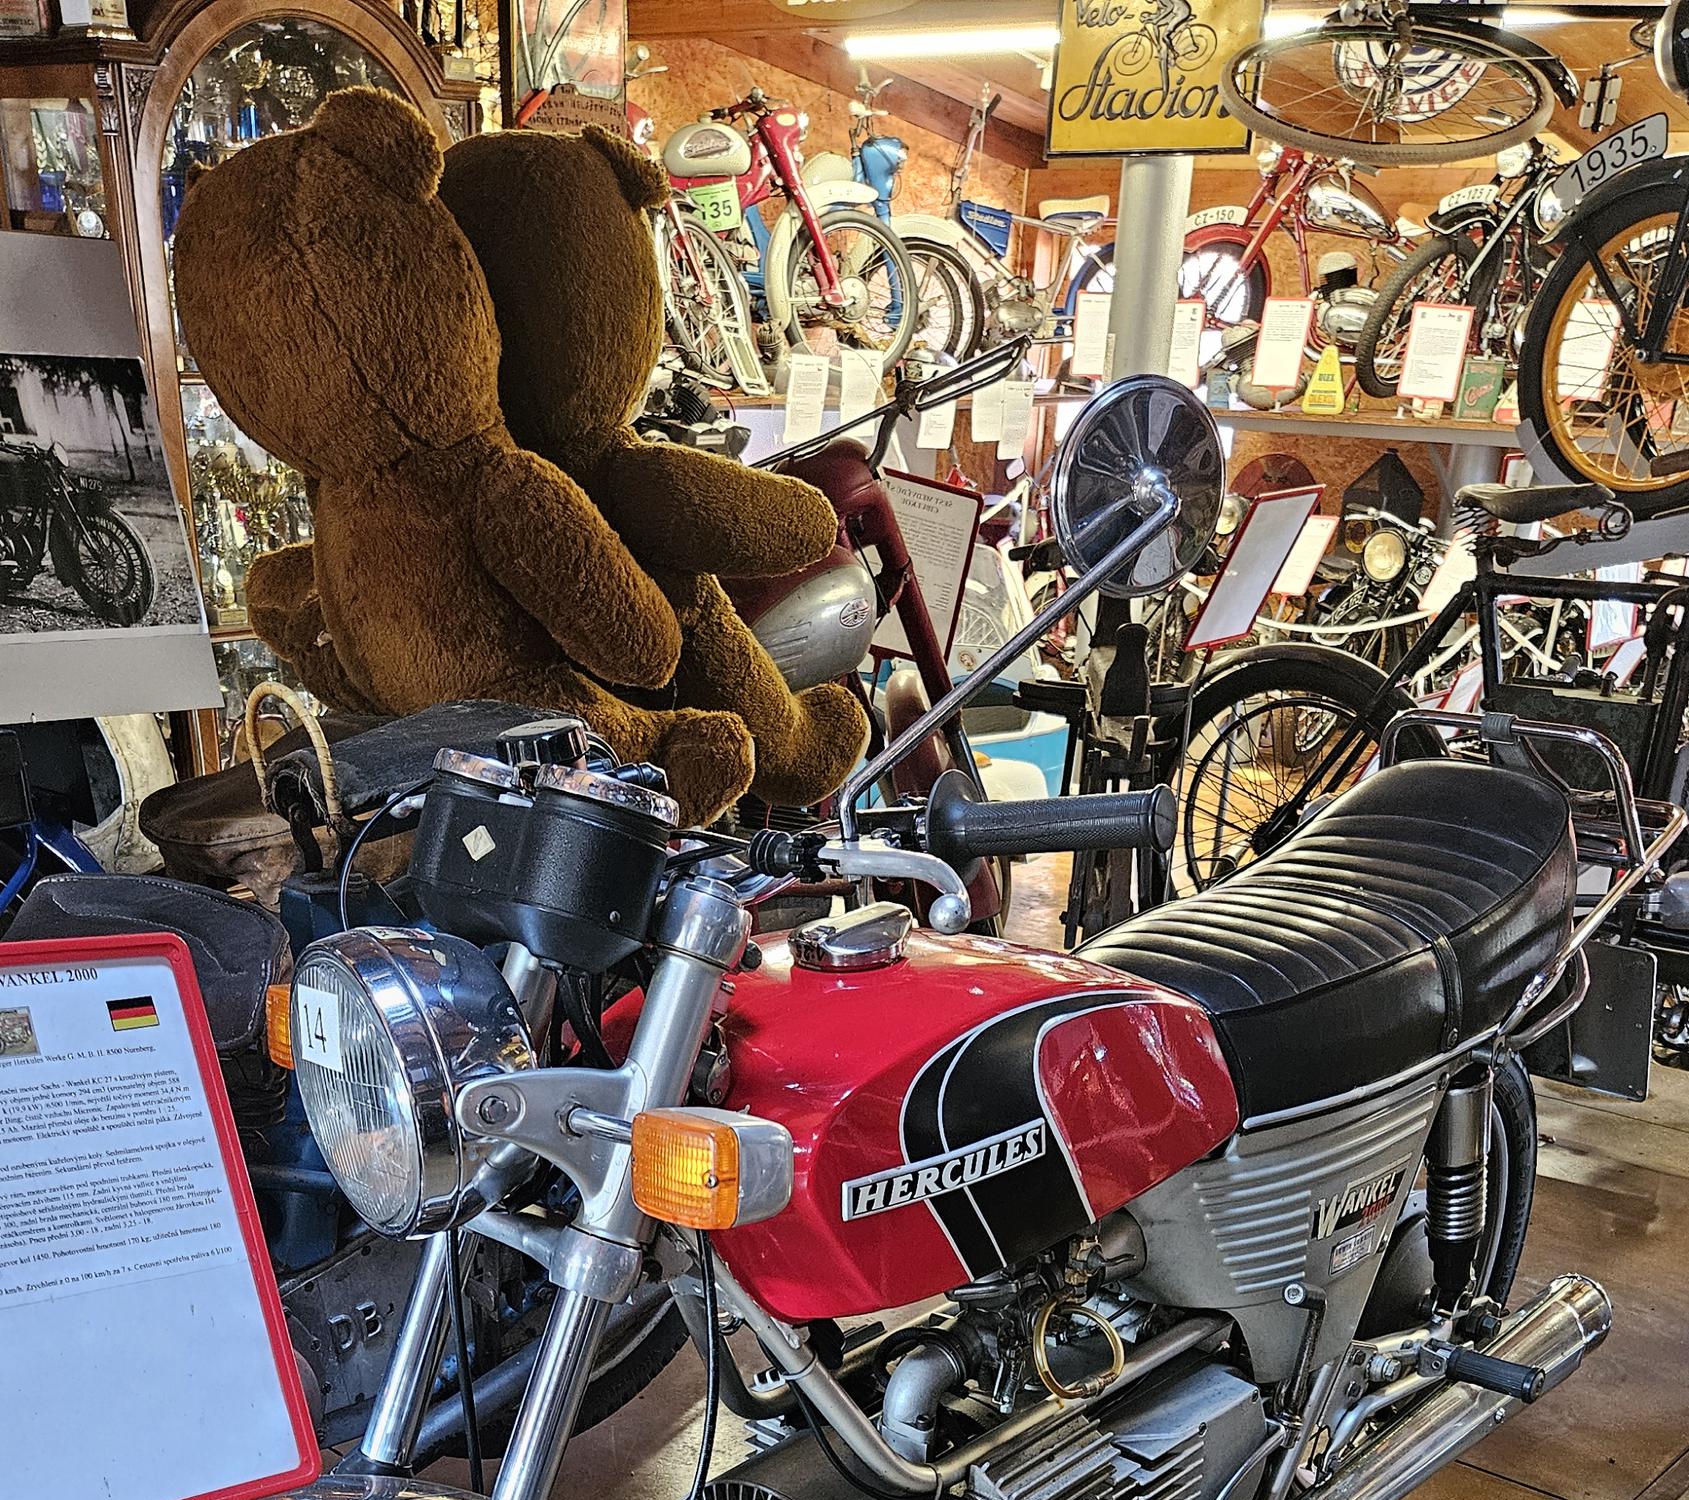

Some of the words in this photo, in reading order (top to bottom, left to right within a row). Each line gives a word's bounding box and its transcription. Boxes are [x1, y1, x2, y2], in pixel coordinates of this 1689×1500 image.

[1571, 124, 1648, 192] 1935
[66, 968, 98, 982] 2000
[304, 1003, 327, 1053] 14
[854, 1128, 1041, 1215] HERCULES
[1317, 1171, 1397, 1241] WANKEL
